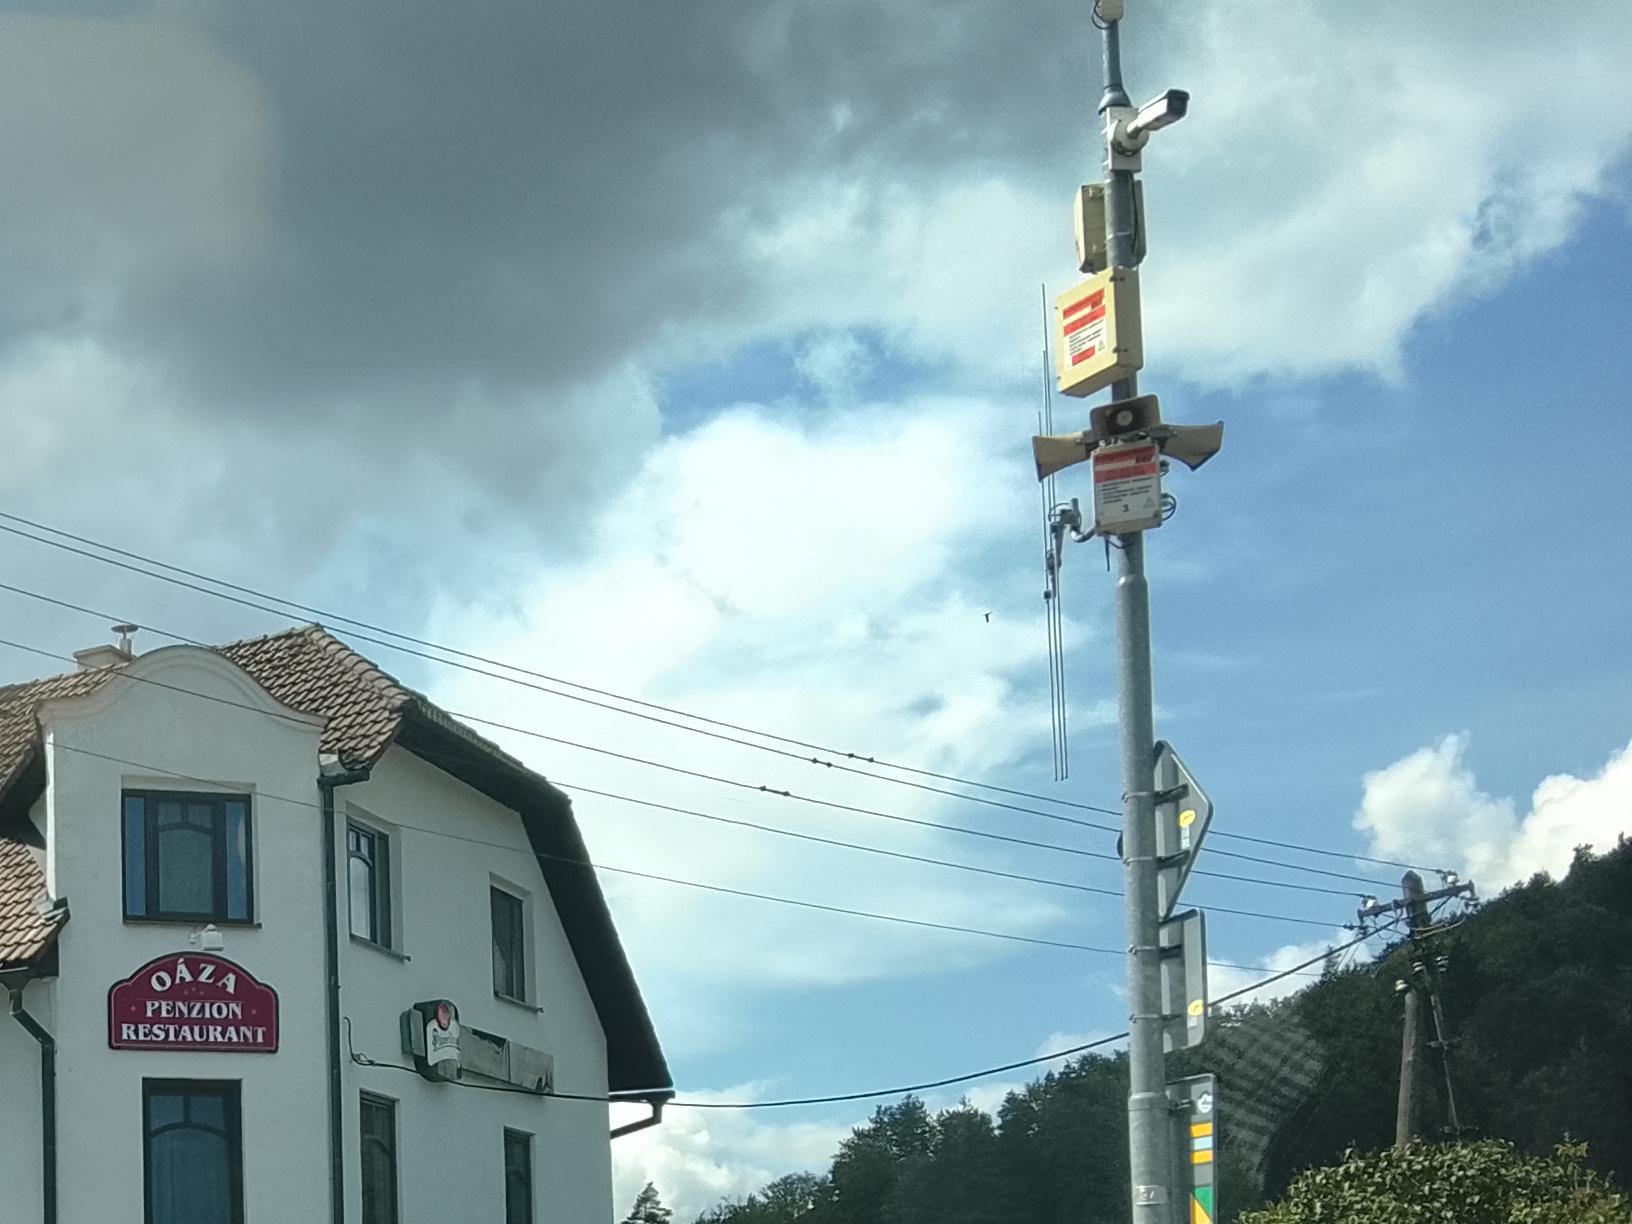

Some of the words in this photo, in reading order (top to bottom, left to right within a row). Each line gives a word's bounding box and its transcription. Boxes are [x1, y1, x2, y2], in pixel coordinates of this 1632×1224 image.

[150, 957, 237, 994] OÁZA
[145, 1000, 243, 1019] PENZION
[121, 1023, 267, 1043] RESTAURANT
